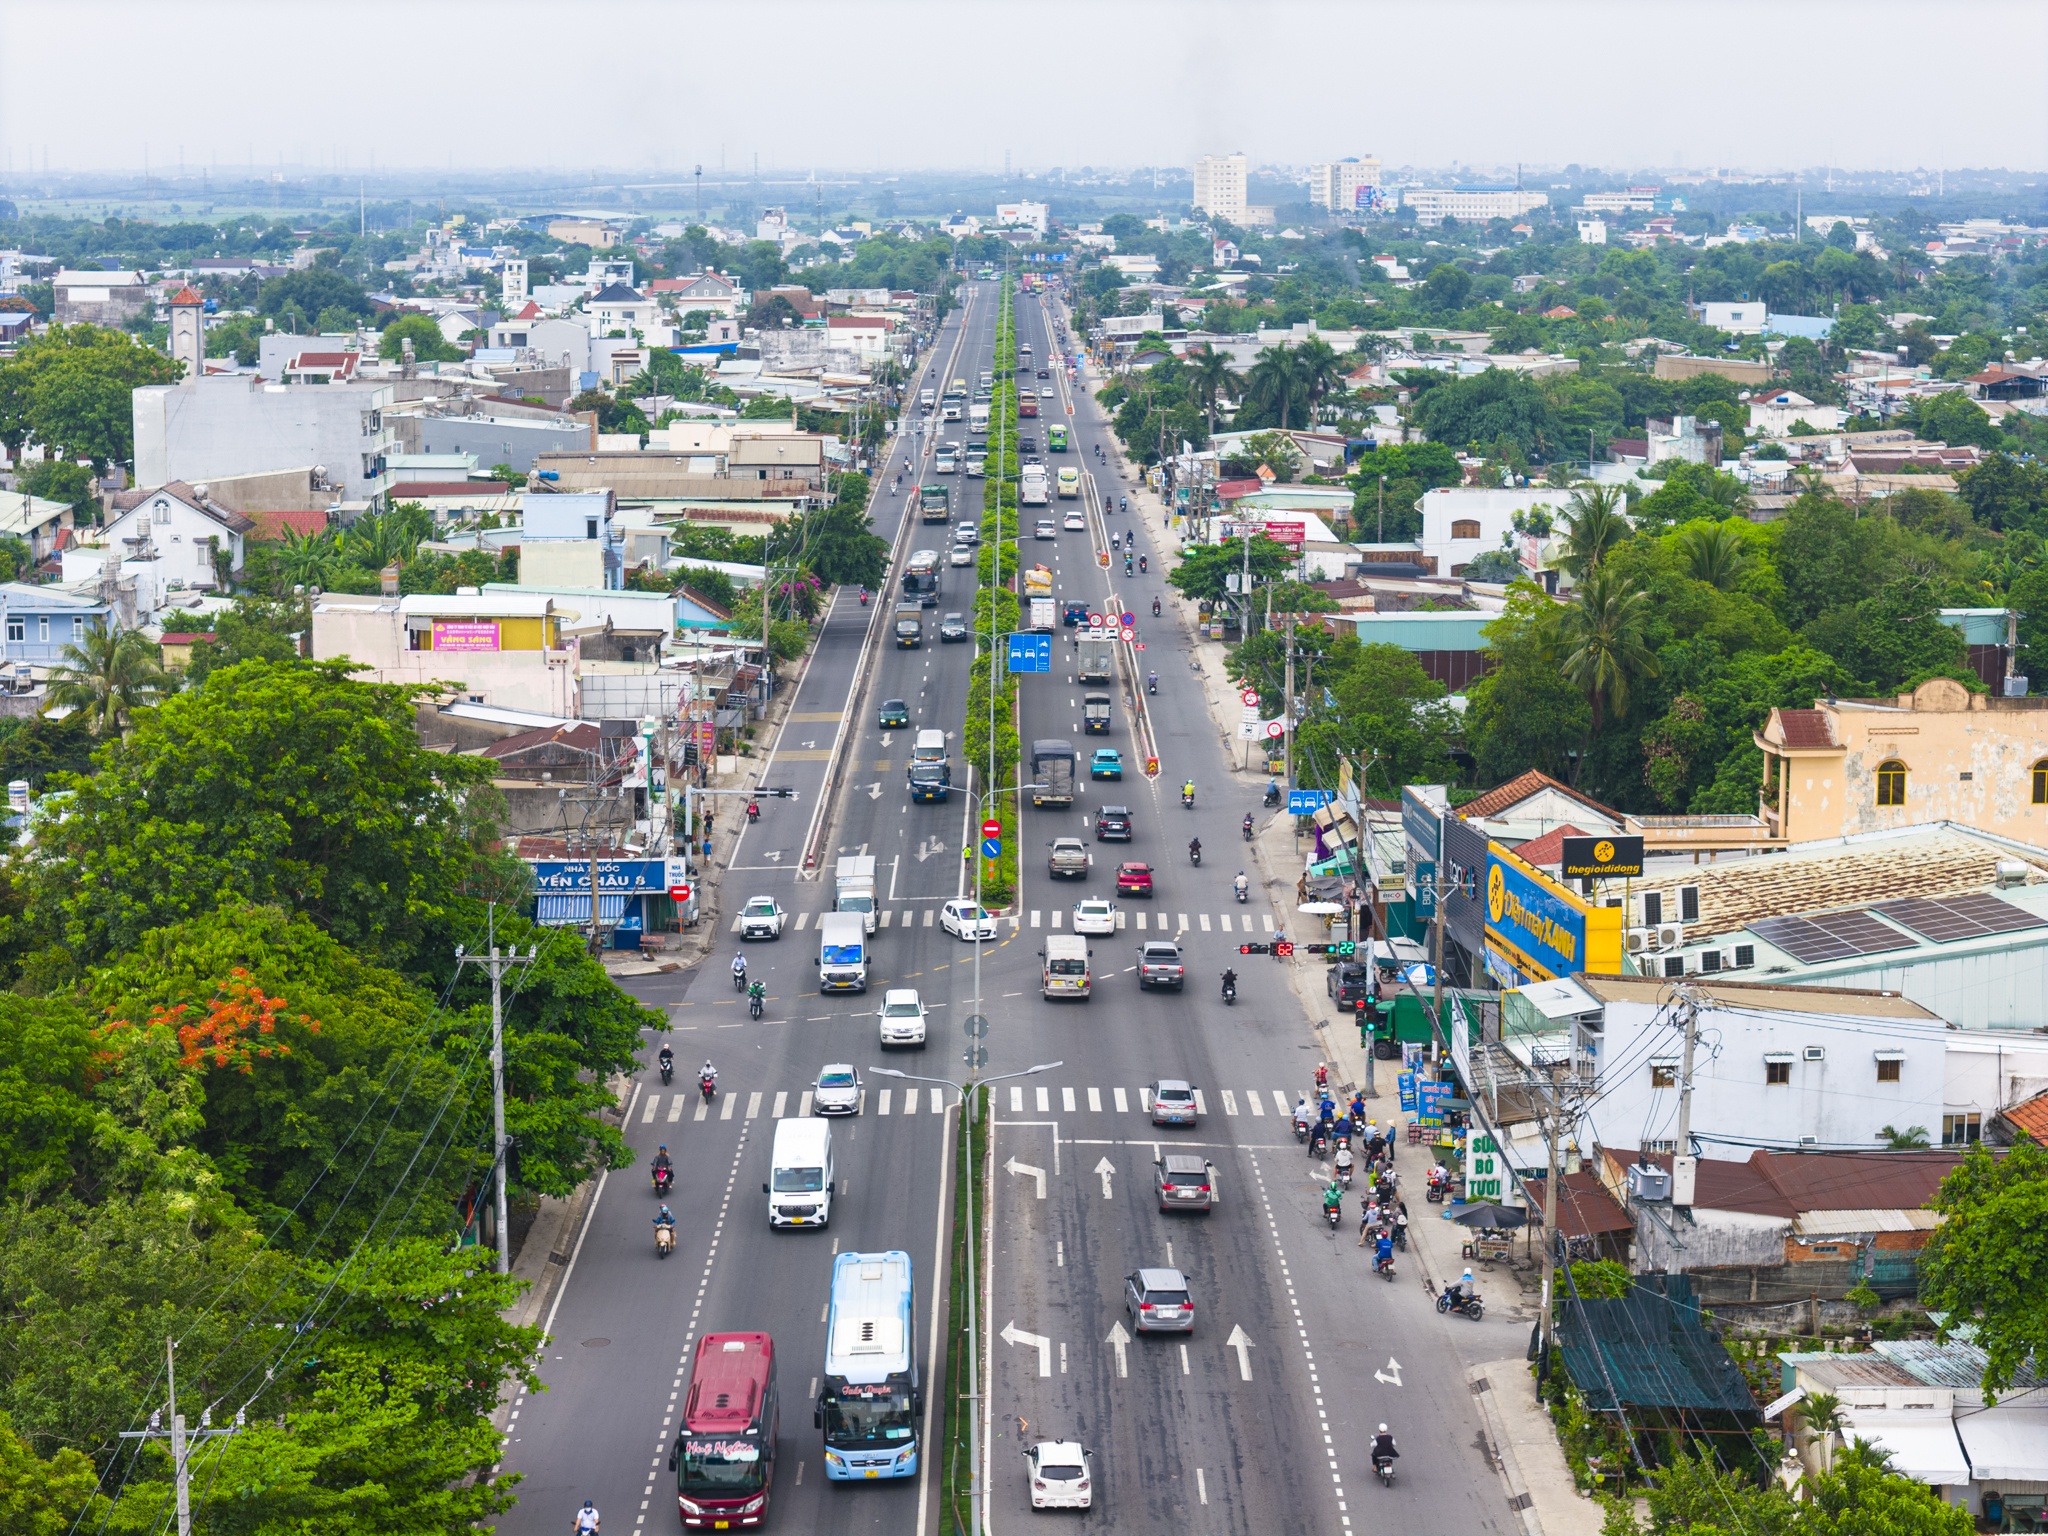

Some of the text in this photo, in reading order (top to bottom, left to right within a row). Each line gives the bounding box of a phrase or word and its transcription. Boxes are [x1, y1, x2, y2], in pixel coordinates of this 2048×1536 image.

[564, 864, 584, 873] NHÀ
[539, 872, 572, 887] YẾN
[635, 875, 646, 886] 8
[1543, 916, 1576, 963] XANH
[1278, 942, 1354, 956] 62 22
[1475, 1155, 1494, 1174] BÒ
[1469, 1179, 1501, 1195] TƯƠI
